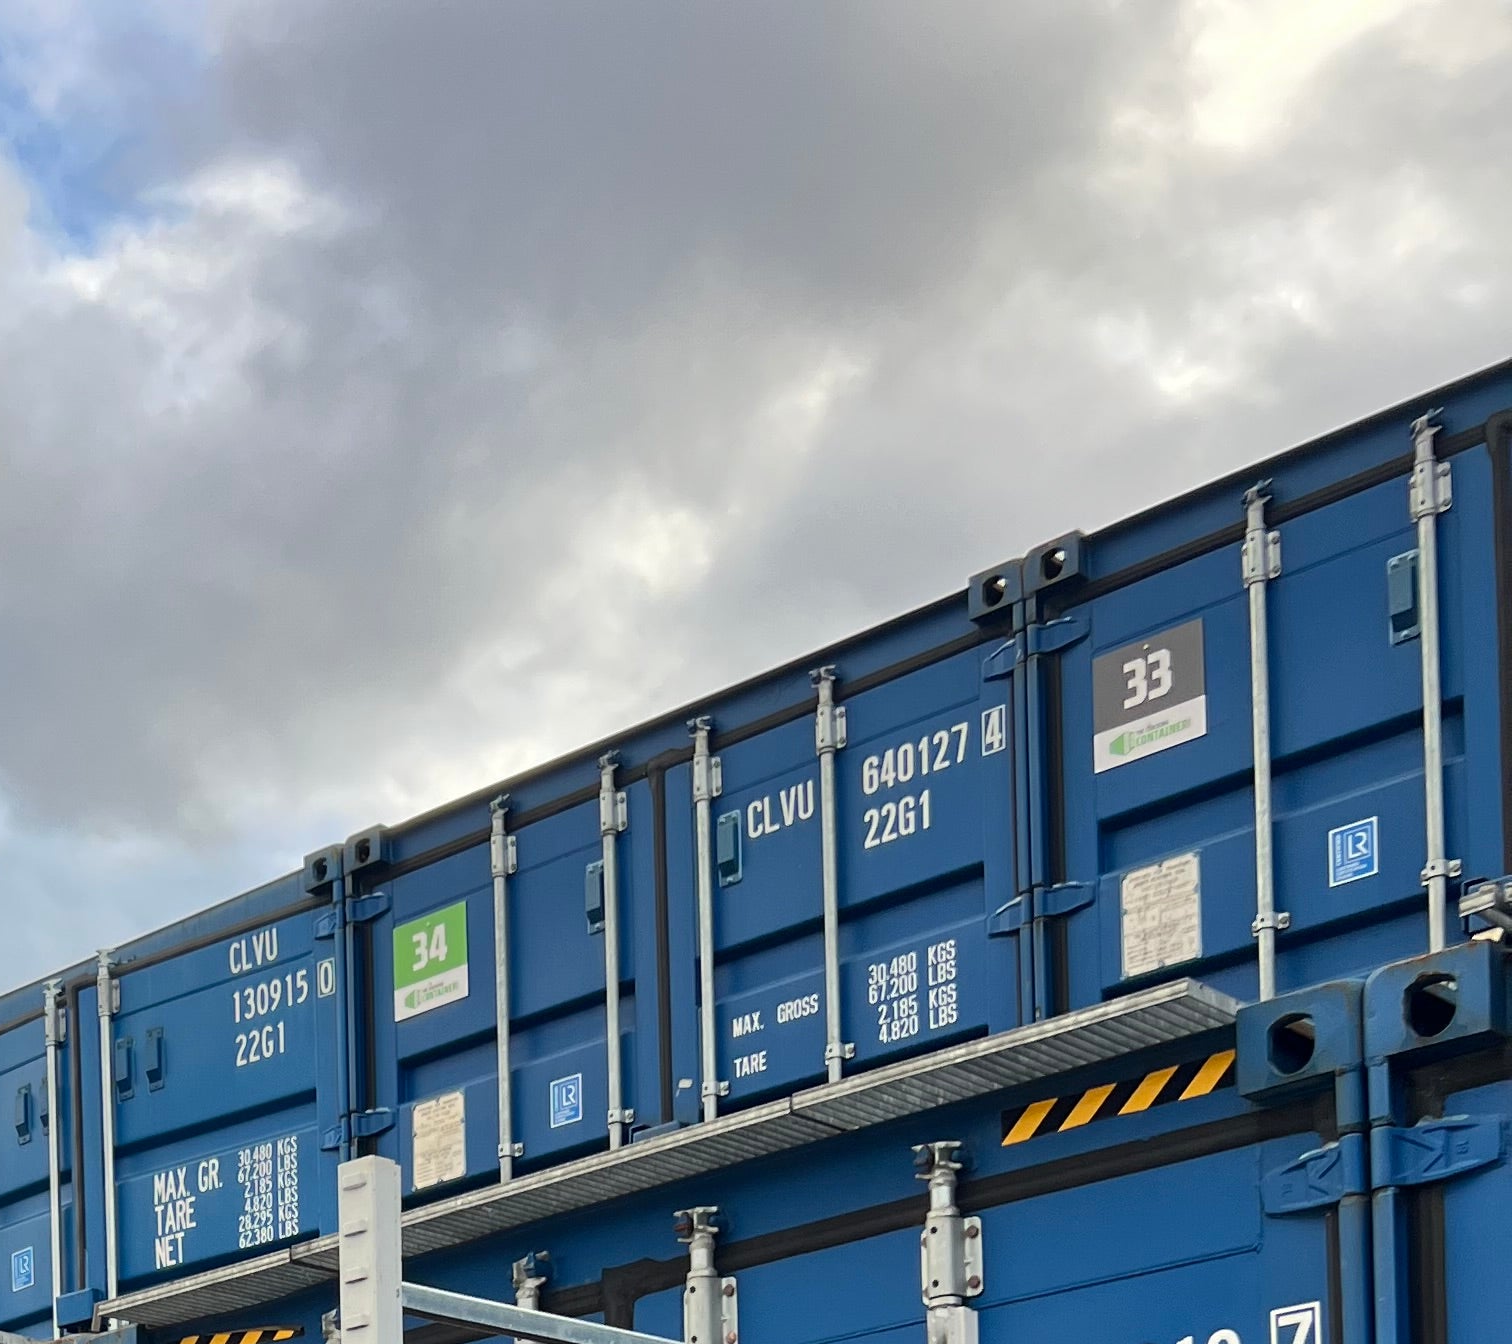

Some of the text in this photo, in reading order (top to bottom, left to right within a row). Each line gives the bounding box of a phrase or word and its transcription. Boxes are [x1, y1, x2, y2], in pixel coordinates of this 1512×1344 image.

[1123, 648, 1173, 710] 33
[746, 706, 1004, 839] CLVU 640127 4
[863, 789, 931, 849] 22G1
[229, 927, 278, 974] CLVU
[412, 922, 448, 972] 34
[927, 939, 956, 967] KGS
[928, 960, 957, 987] LBS
[232, 959, 334, 1023] 130915 0
[928, 983, 957, 1010] KGS
[732, 993, 819, 1038] MAX. GROSS
[929, 1003, 958, 1030] LBS
[235, 1020, 285, 1067] 22G1
[733, 1050, 768, 1078] TARE
[277, 1136, 297, 1155] KGS
[277, 1153, 298, 1173] LBS
[277, 1169, 298, 1189] KGS
[153, 1158, 223, 1206] MAX. GR.
[278, 1186, 298, 1206] LBS
[154, 1196, 197, 1236] TARE
[278, 1202, 299, 1222] KGS
[278, 1218, 299, 1240] LBS
[155, 1232, 185, 1270] NET
